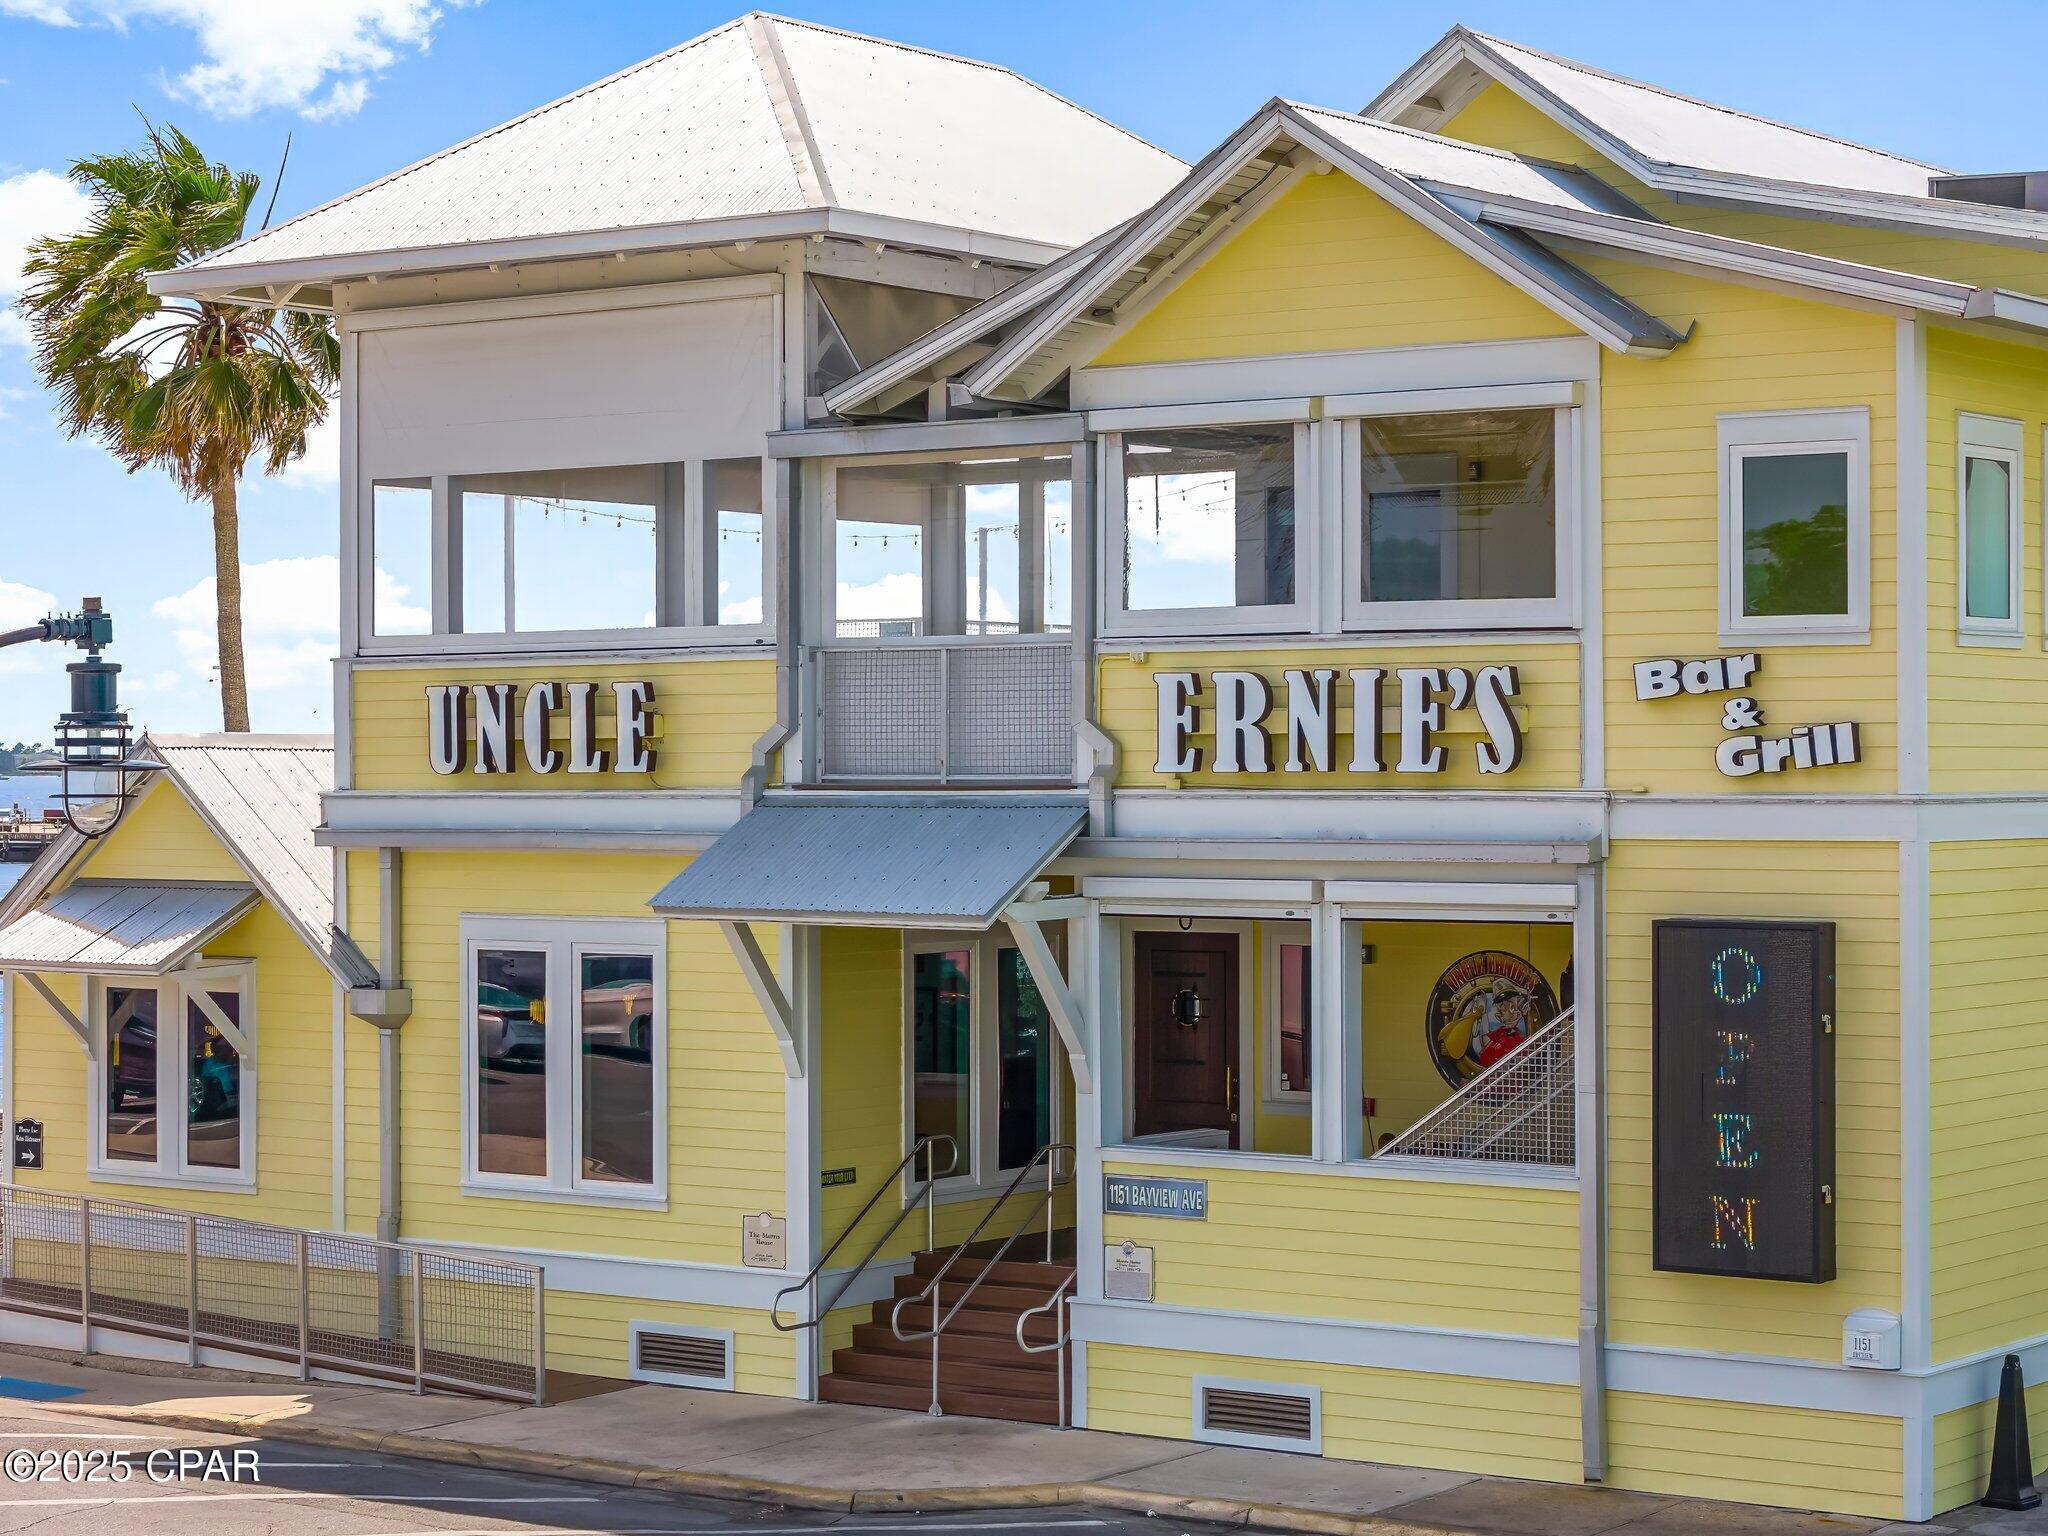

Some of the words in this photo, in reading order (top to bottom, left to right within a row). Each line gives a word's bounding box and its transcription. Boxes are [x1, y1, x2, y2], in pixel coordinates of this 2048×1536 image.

[1633, 653, 1761, 701] Bar
[425, 682, 657, 774] UNCLE
[1153, 665, 1523, 775] ERNIE'S
[1721, 697, 1767, 731] &
[1715, 721, 1862, 777] Grill
[1109, 1184, 1129, 1205] 1151
[1132, 1185, 1178, 1208] BAYVIEW
[1181, 1189, 1203, 1210] AVE
